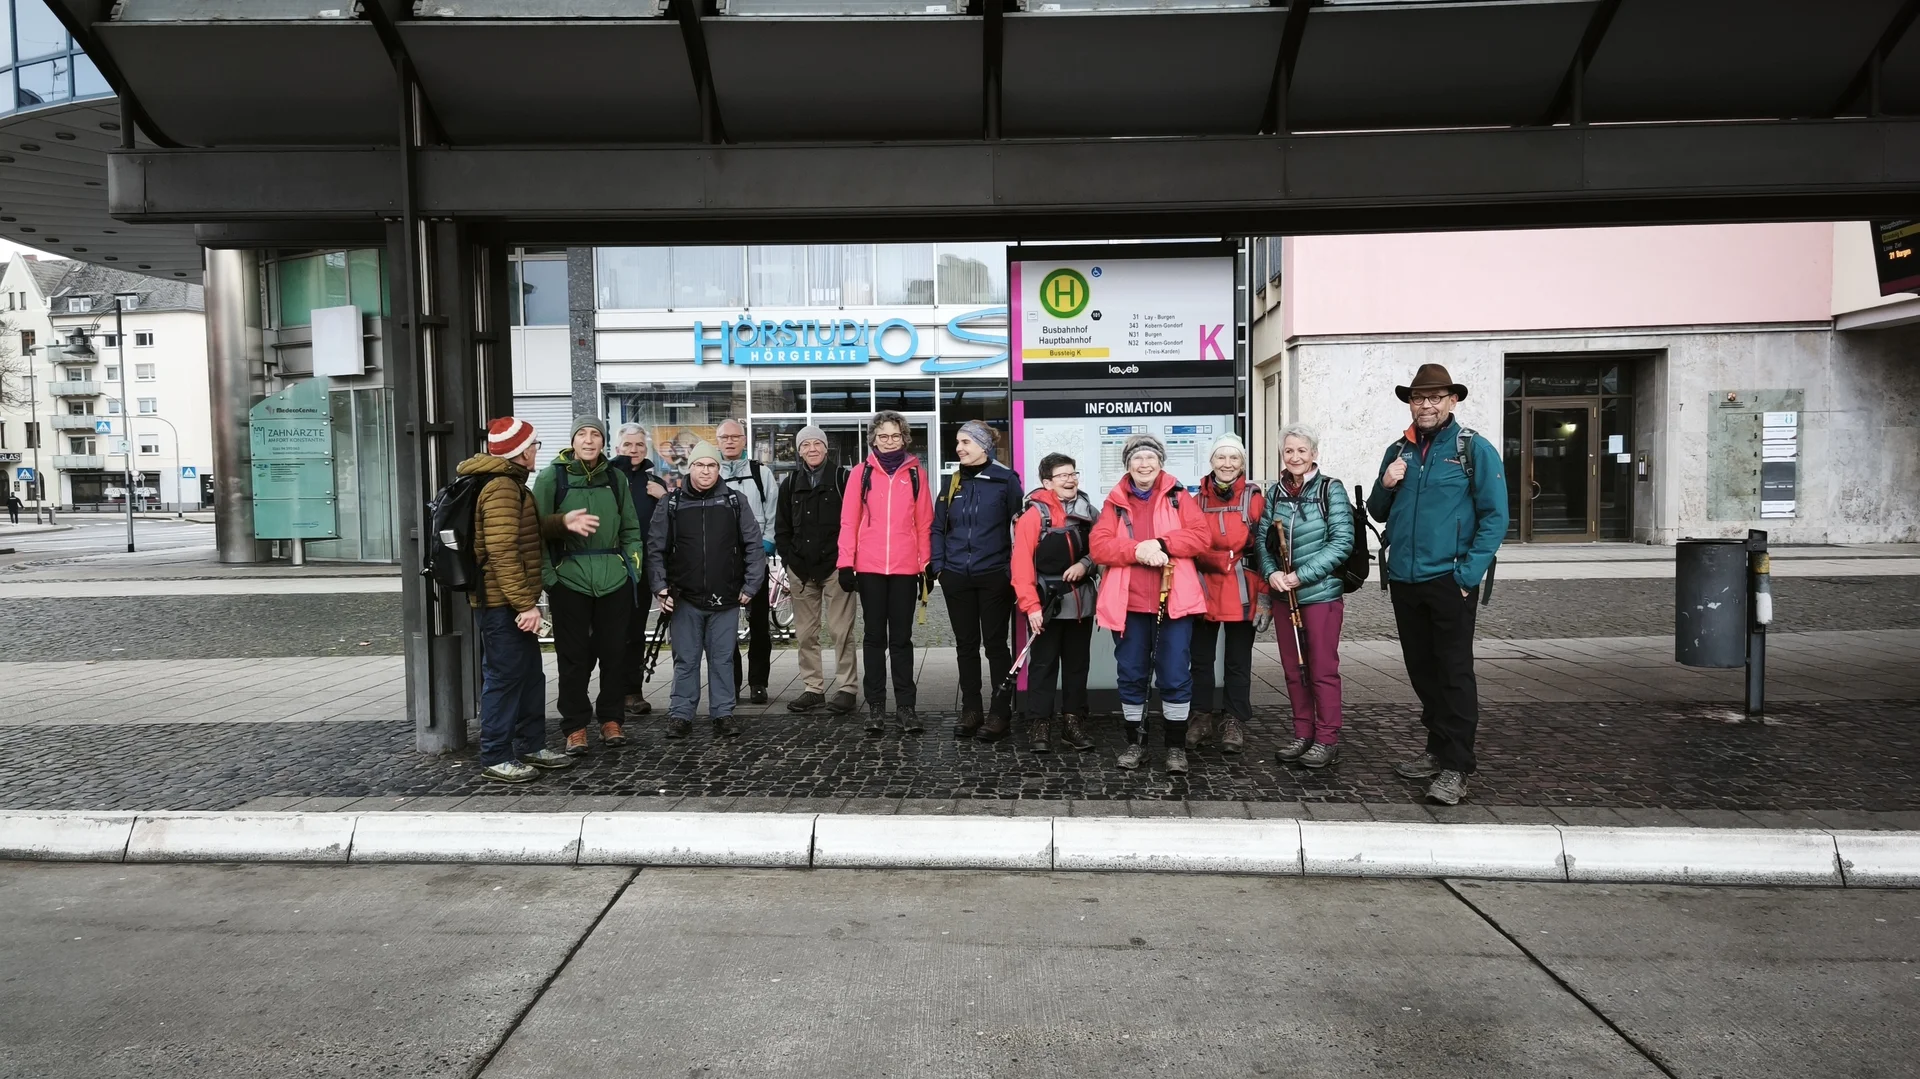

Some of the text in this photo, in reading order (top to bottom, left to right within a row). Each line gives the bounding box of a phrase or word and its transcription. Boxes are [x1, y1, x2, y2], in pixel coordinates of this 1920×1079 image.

[1055, 279, 1075, 308] H
[1042, 325, 1088, 334] Busbahnhof
[694, 314, 919, 365] HÖRSTUDIO
[1039, 336, 1092, 346] Hauptbahnhof
[1199, 324, 1226, 360] K
[750, 348, 857, 362] HÖRGERÄTE
[1049, 349, 1075, 357] Bussteig
[1084, 401, 1172, 414] INFORMATION
[1679, 403, 1684, 411] 7
[267, 427, 325, 438] ZAHNÄRZTE
